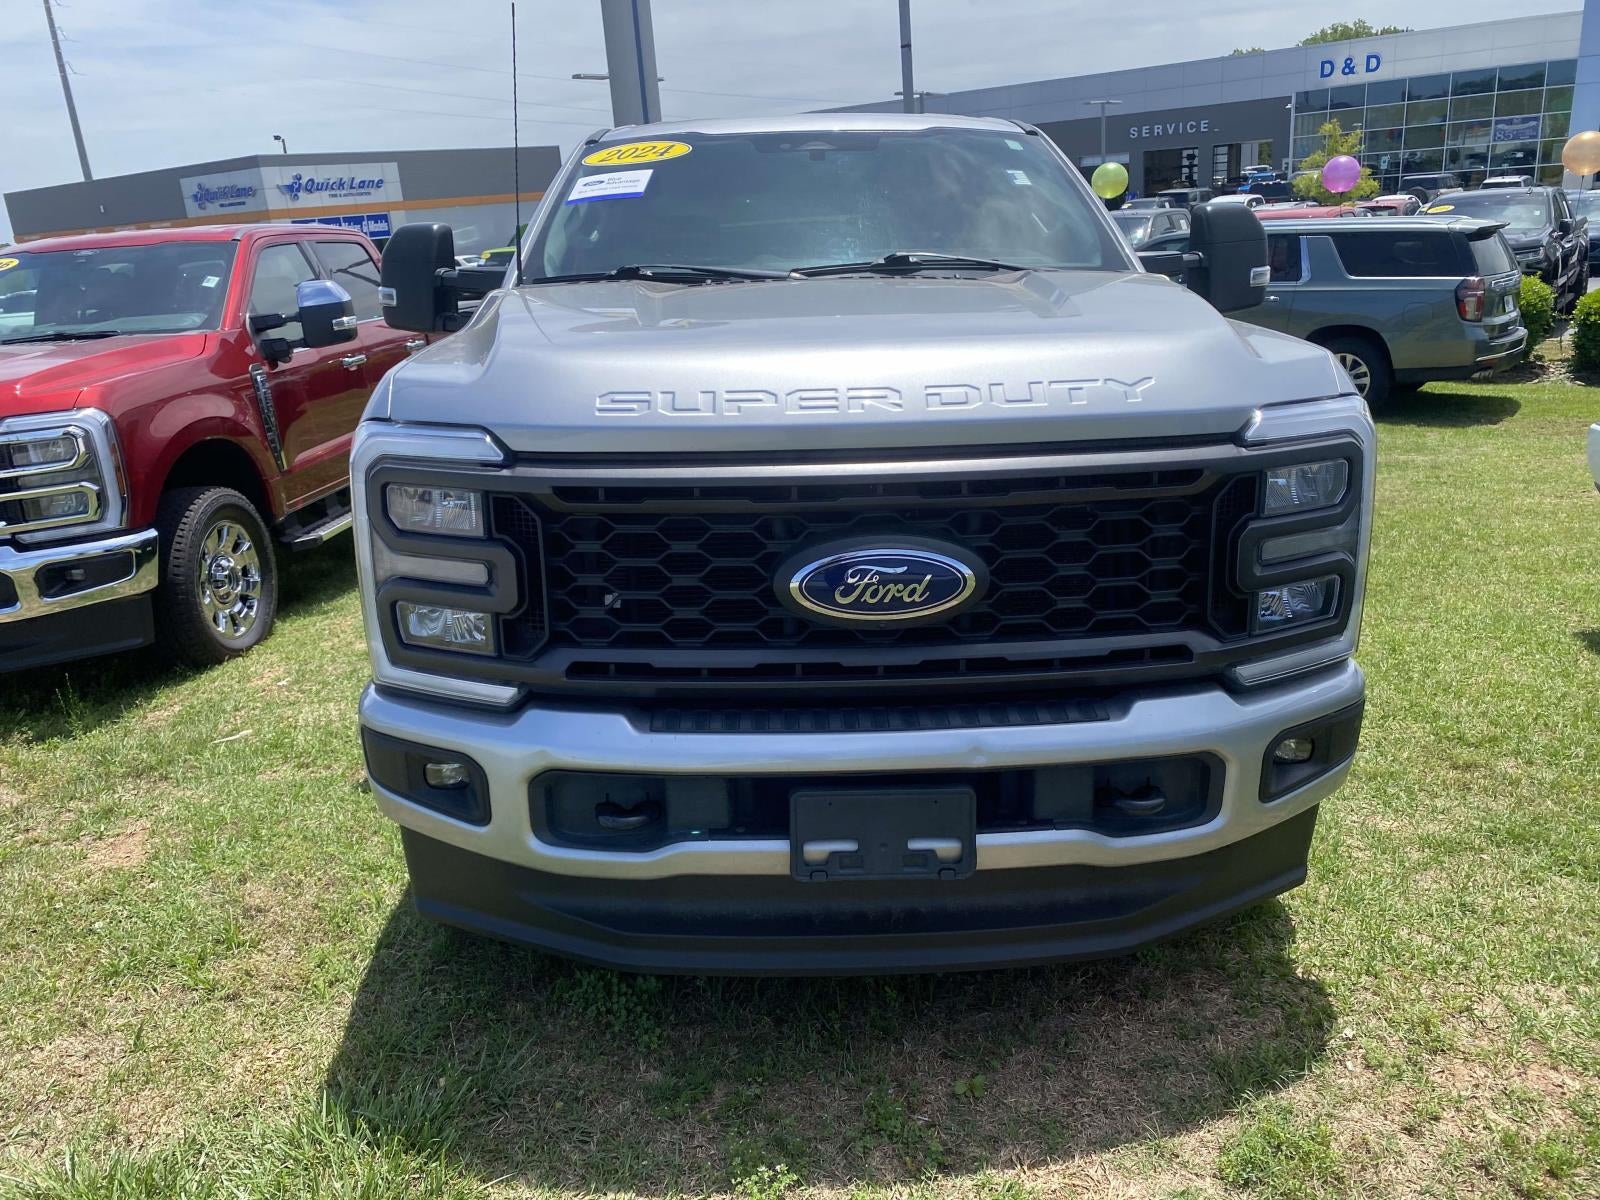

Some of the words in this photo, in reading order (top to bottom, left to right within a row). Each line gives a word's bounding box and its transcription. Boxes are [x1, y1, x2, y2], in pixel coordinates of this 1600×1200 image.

[1320, 60, 1335, 78] D
[1341, 57, 1356, 75] &
[1365, 54, 1381, 73] D
[1128, 119, 1209, 139] SERVICE
[597, 144, 676, 163] 2024
[305, 177, 346, 194] Quick
[349, 176, 384, 190] Lane
[594, 386, 905, 417] SUPER
[924, 376, 1156, 411] DUTY
[834, 565, 932, 605] Ford
